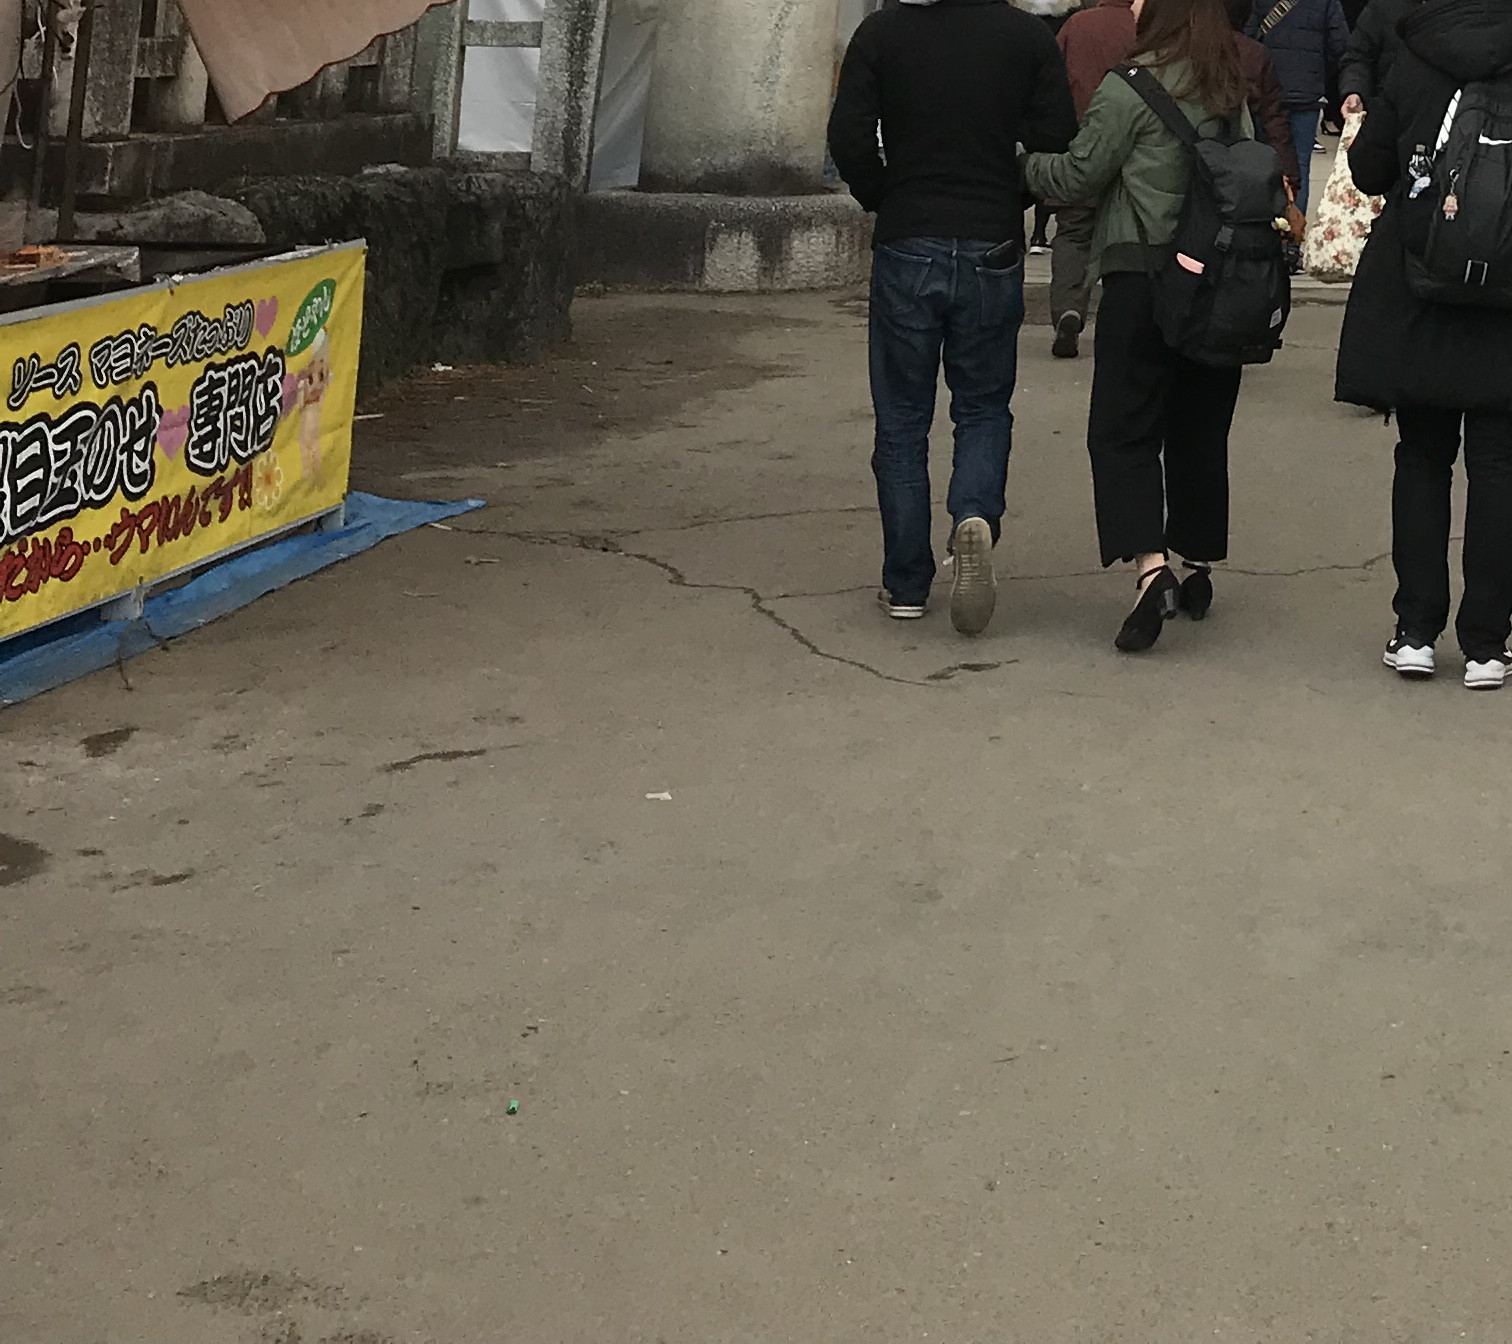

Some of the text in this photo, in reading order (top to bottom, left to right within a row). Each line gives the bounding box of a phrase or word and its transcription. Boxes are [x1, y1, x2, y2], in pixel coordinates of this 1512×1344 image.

[0, 347, 285, 546] 目玉のせ 専門店
